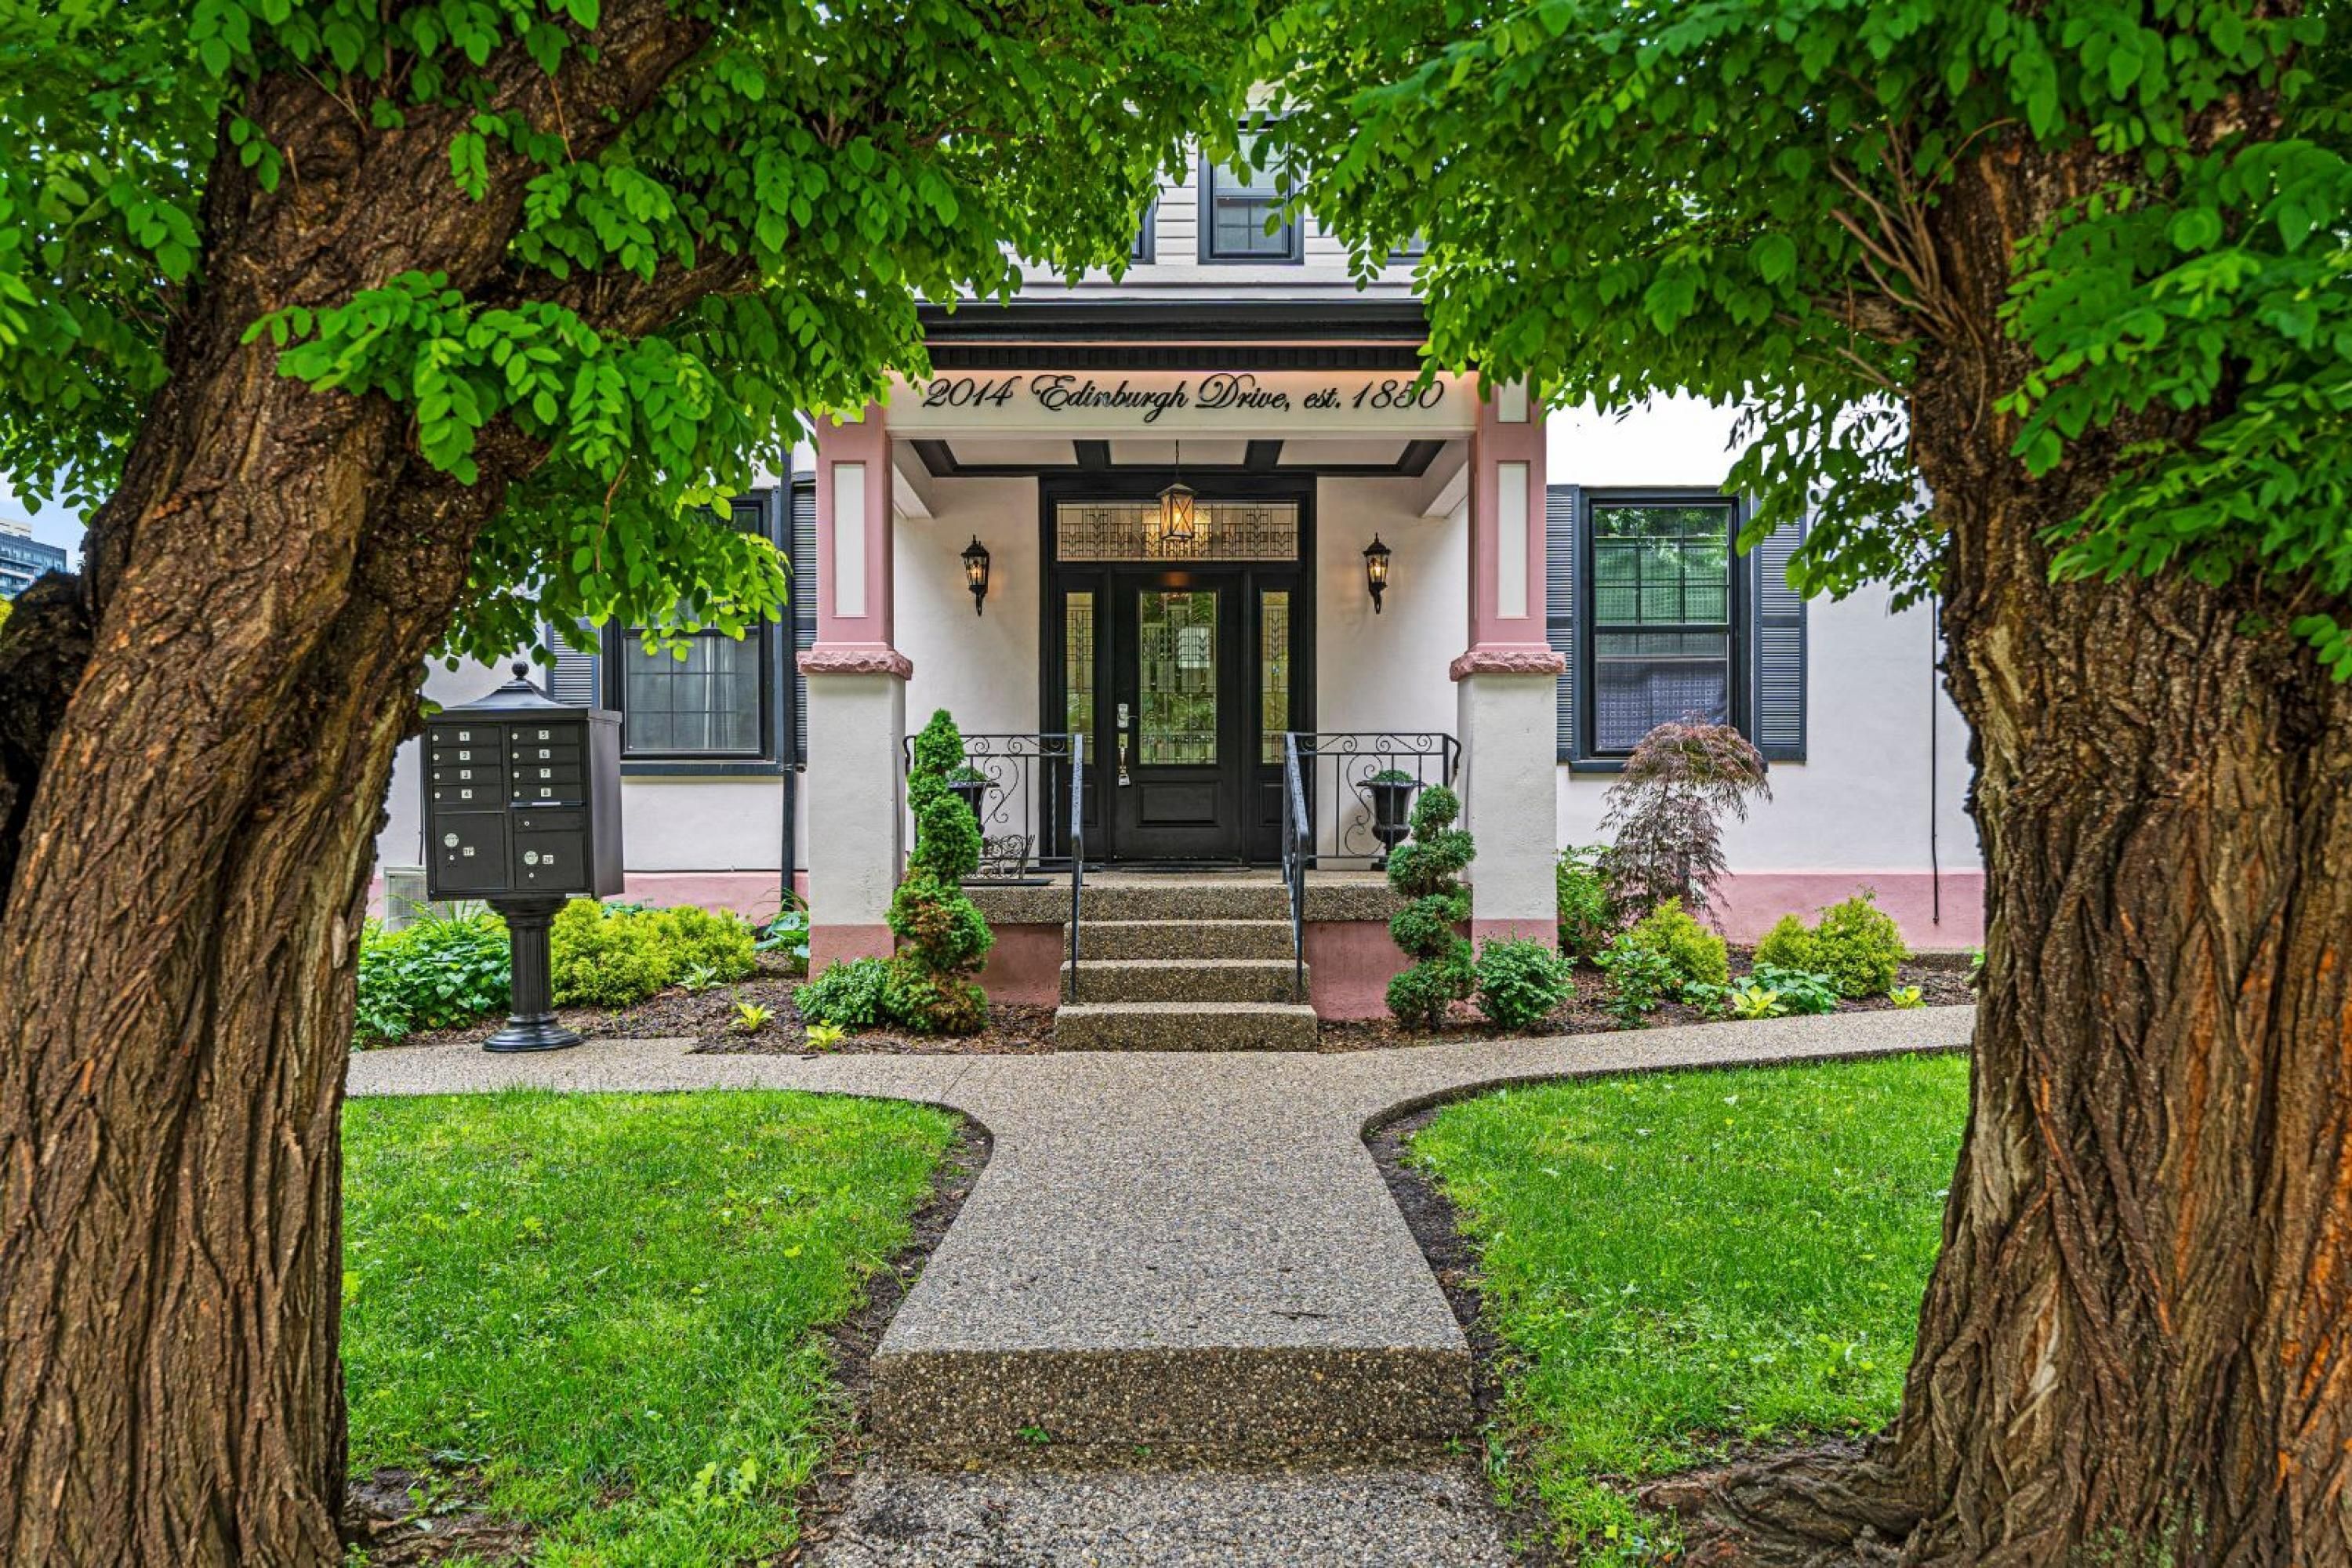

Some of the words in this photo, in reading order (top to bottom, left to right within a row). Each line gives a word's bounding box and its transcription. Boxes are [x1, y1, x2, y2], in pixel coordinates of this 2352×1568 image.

[923, 376, 1022, 408] 2014
[1030, 374, 1190, 424] Edinburgh
[1195, 372, 1290, 412] Drive,
[1304, 387, 1341, 409] est.
